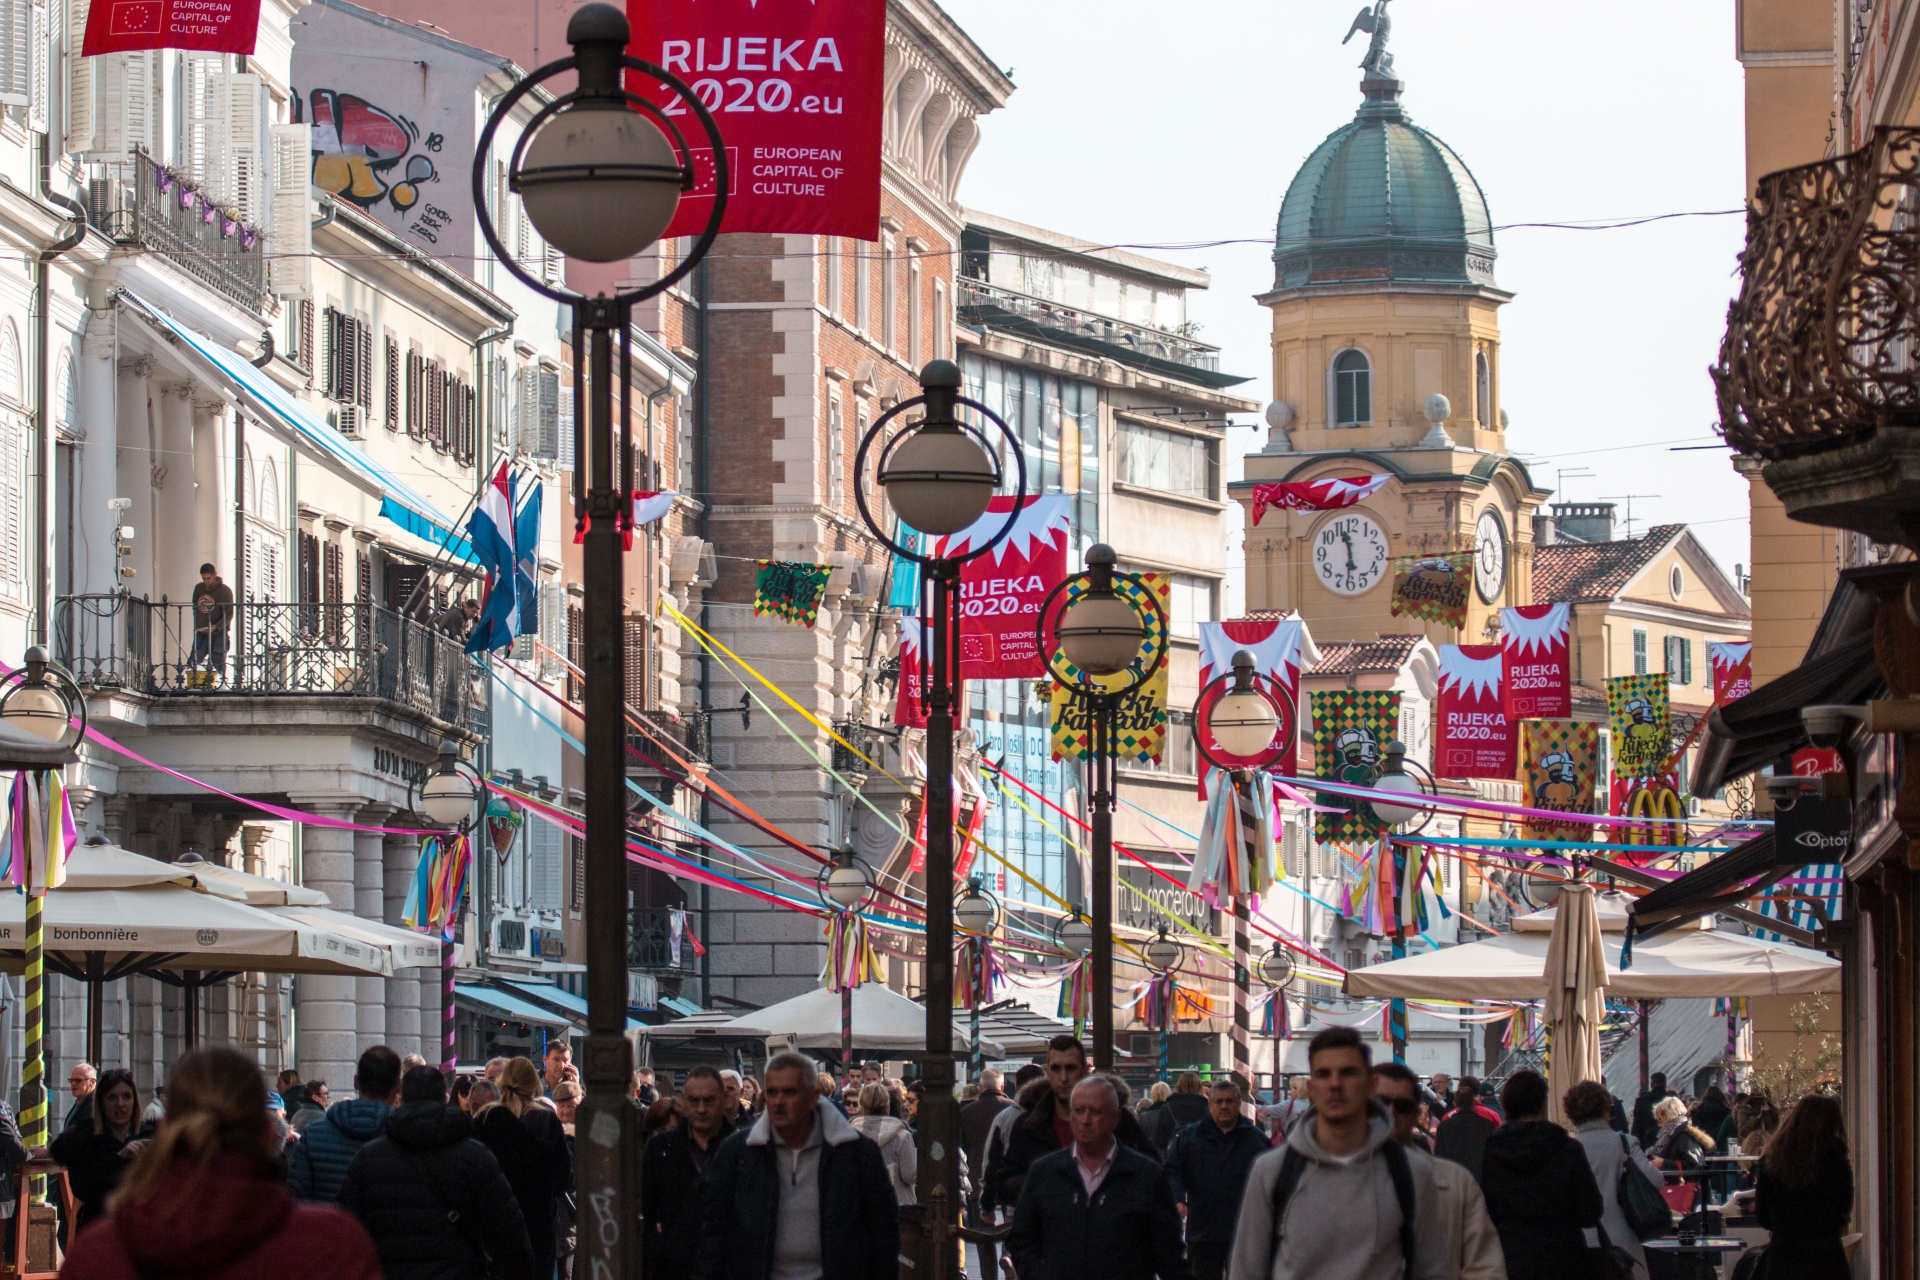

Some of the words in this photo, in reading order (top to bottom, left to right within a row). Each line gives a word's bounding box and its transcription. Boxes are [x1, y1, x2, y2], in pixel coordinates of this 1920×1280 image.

[173, 0, 231, 12] EUROPEAN
[171, 12, 214, 22] CAPITAL
[215, 14, 231, 24] OF
[170, 23, 218, 35] CULTURE
[660, 36, 844, 73] RIJEKA
[658, 77, 844, 116] 2020.eu
[425, 131, 444, 152] 18
[753, 147, 842, 161] EUROPEAN
[752, 164, 818, 178] CAPITAL
[821, 167, 844, 179] OF
[752, 182, 826, 196] CULTURE
[1346, 517, 1359, 534] 12
[1321, 529, 1336, 546] 10
[1000, 643, 1035, 651] CAPITAL
[1511, 664, 1561, 677] RIJEKA
[1511, 677, 1561, 690] 2020.eu
[1447, 712, 1507, 726] RIJEKA
[1446, 726, 1507, 740] 2020.eu
[53, 927, 139, 941] bonbonnière
